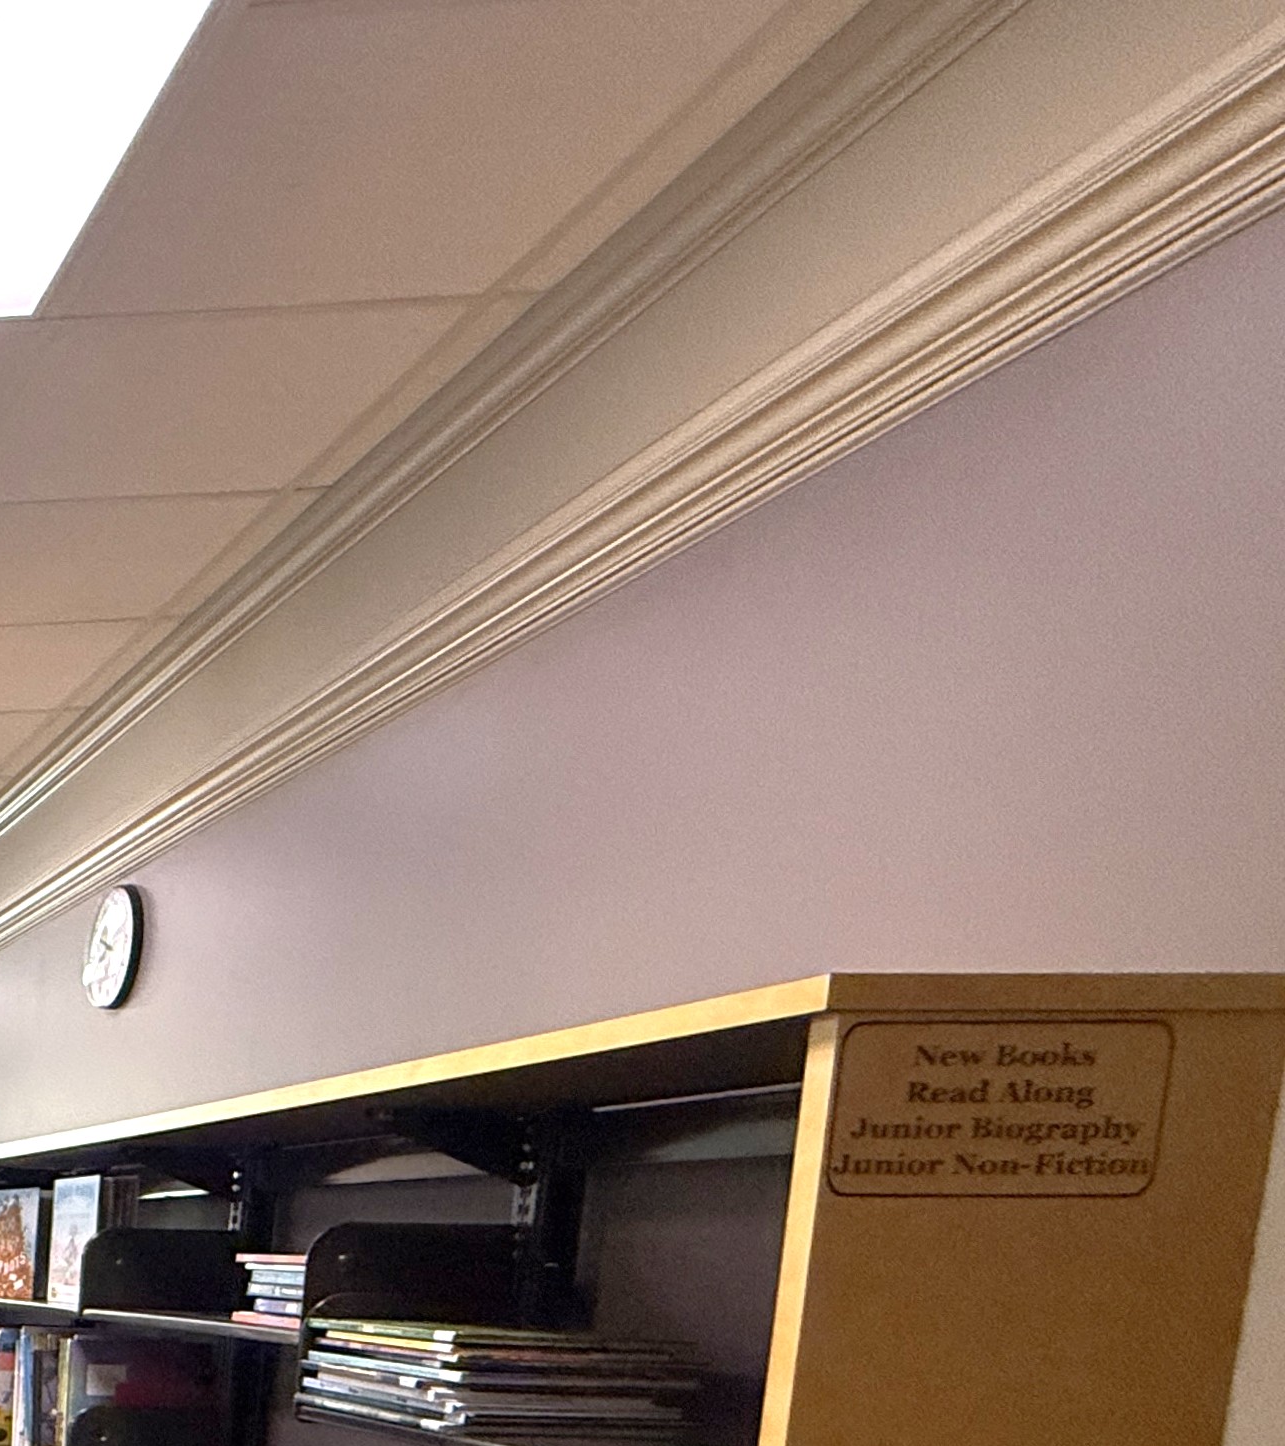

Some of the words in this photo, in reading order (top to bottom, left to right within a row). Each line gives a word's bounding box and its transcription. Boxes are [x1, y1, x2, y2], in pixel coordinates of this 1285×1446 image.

[914, 1045, 985, 1067] New
[996, 1042, 1096, 1067] Books
[907, 1080, 990, 1103] Read
[1004, 1080, 1096, 1109] Along
[850, 1117, 962, 1140] Junior
[971, 1117, 1143, 1146] Biography
[832, 1153, 945, 1176] Junior
[952, 1152, 1149, 1176] Non-Fiction
